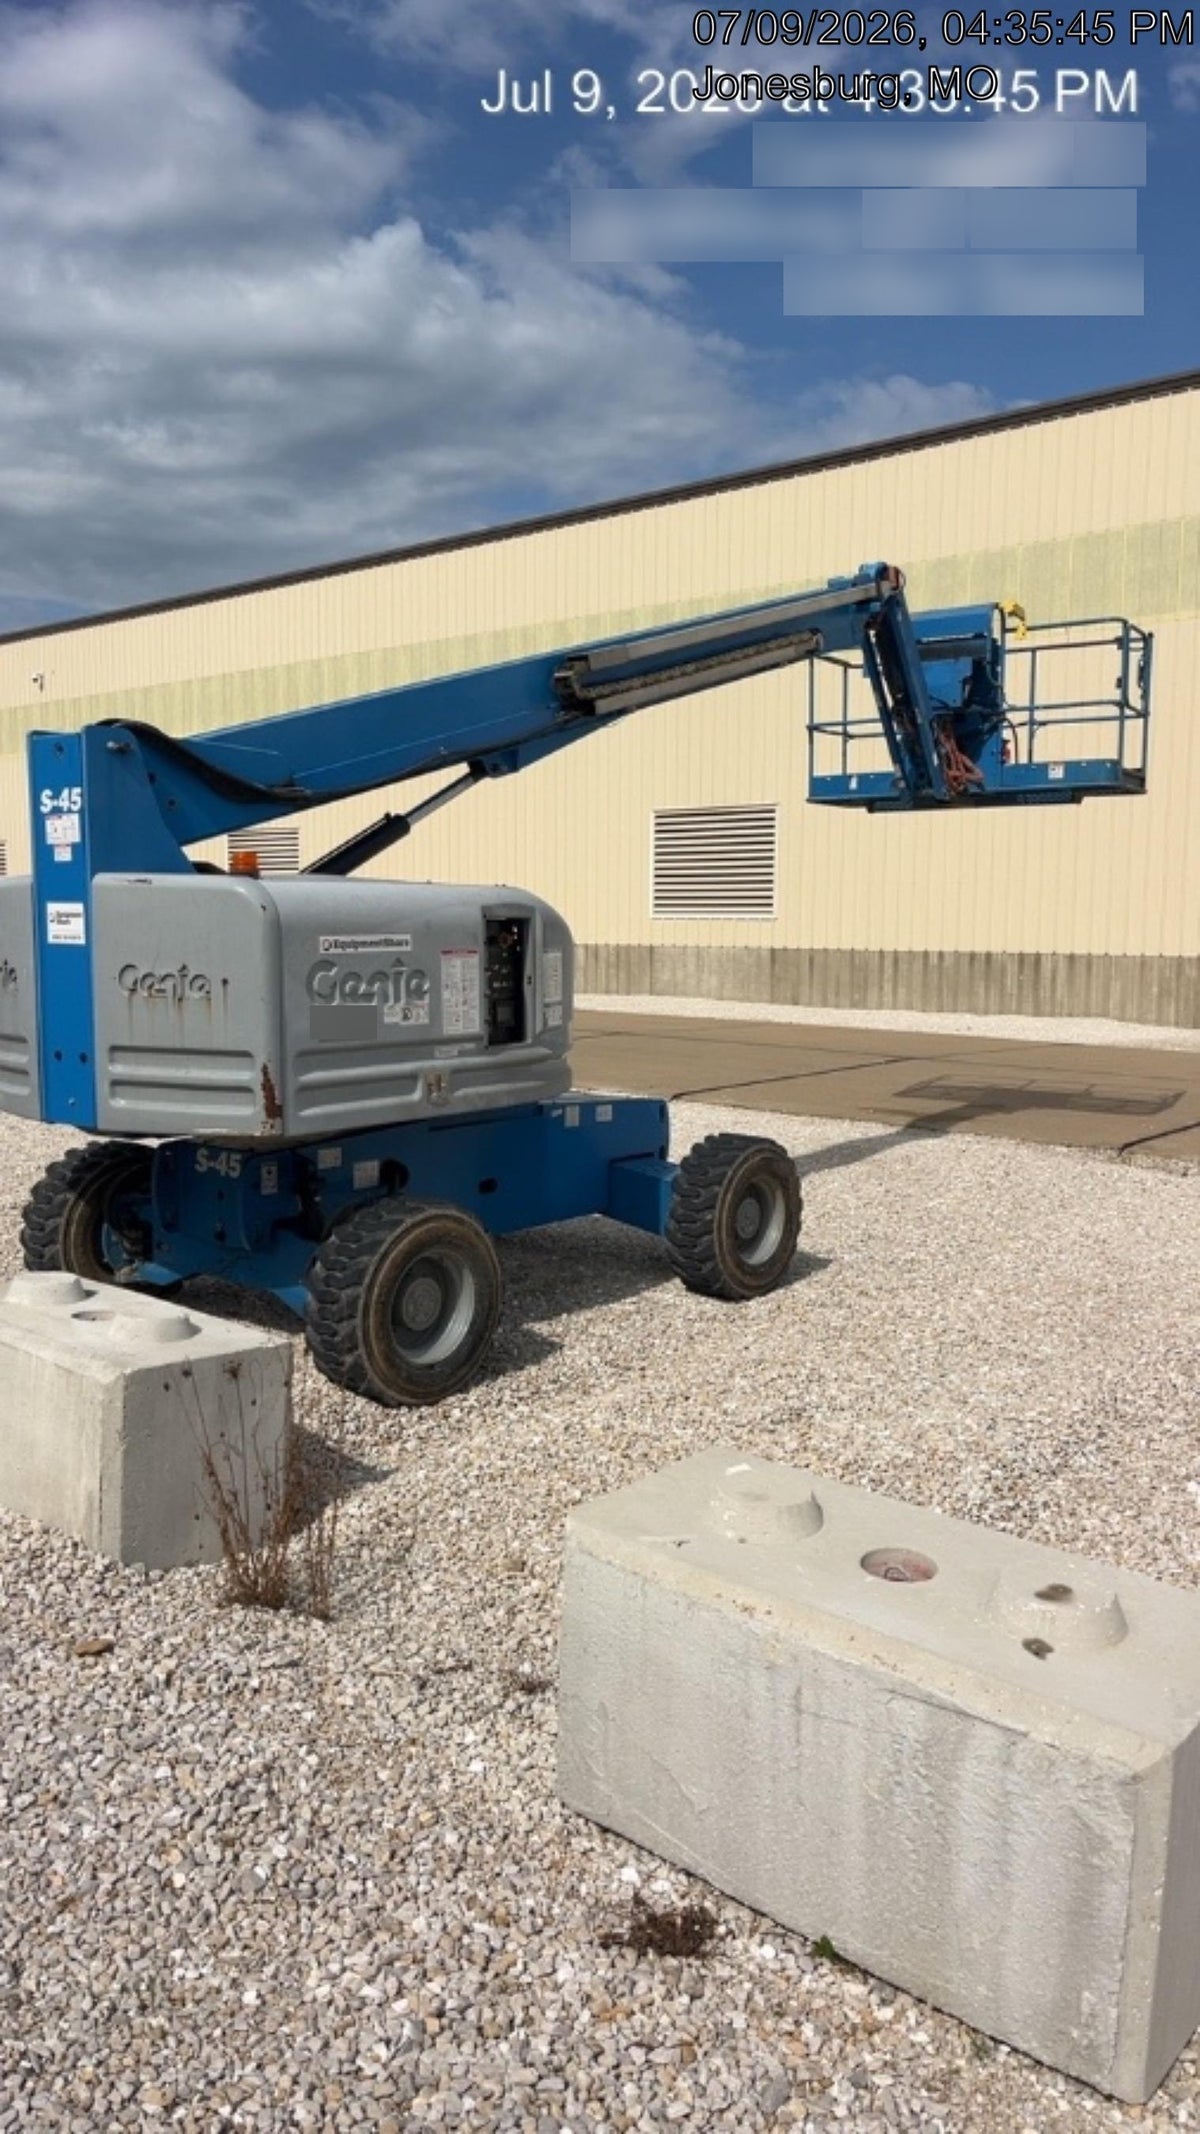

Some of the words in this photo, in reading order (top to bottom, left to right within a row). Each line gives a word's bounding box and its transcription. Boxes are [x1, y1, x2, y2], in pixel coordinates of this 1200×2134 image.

[40, 786, 82, 814] S-45
[118, 963, 212, 1001] Genie
[305, 957, 430, 1006] Genie
[194, 1147, 243, 1178] S-45
